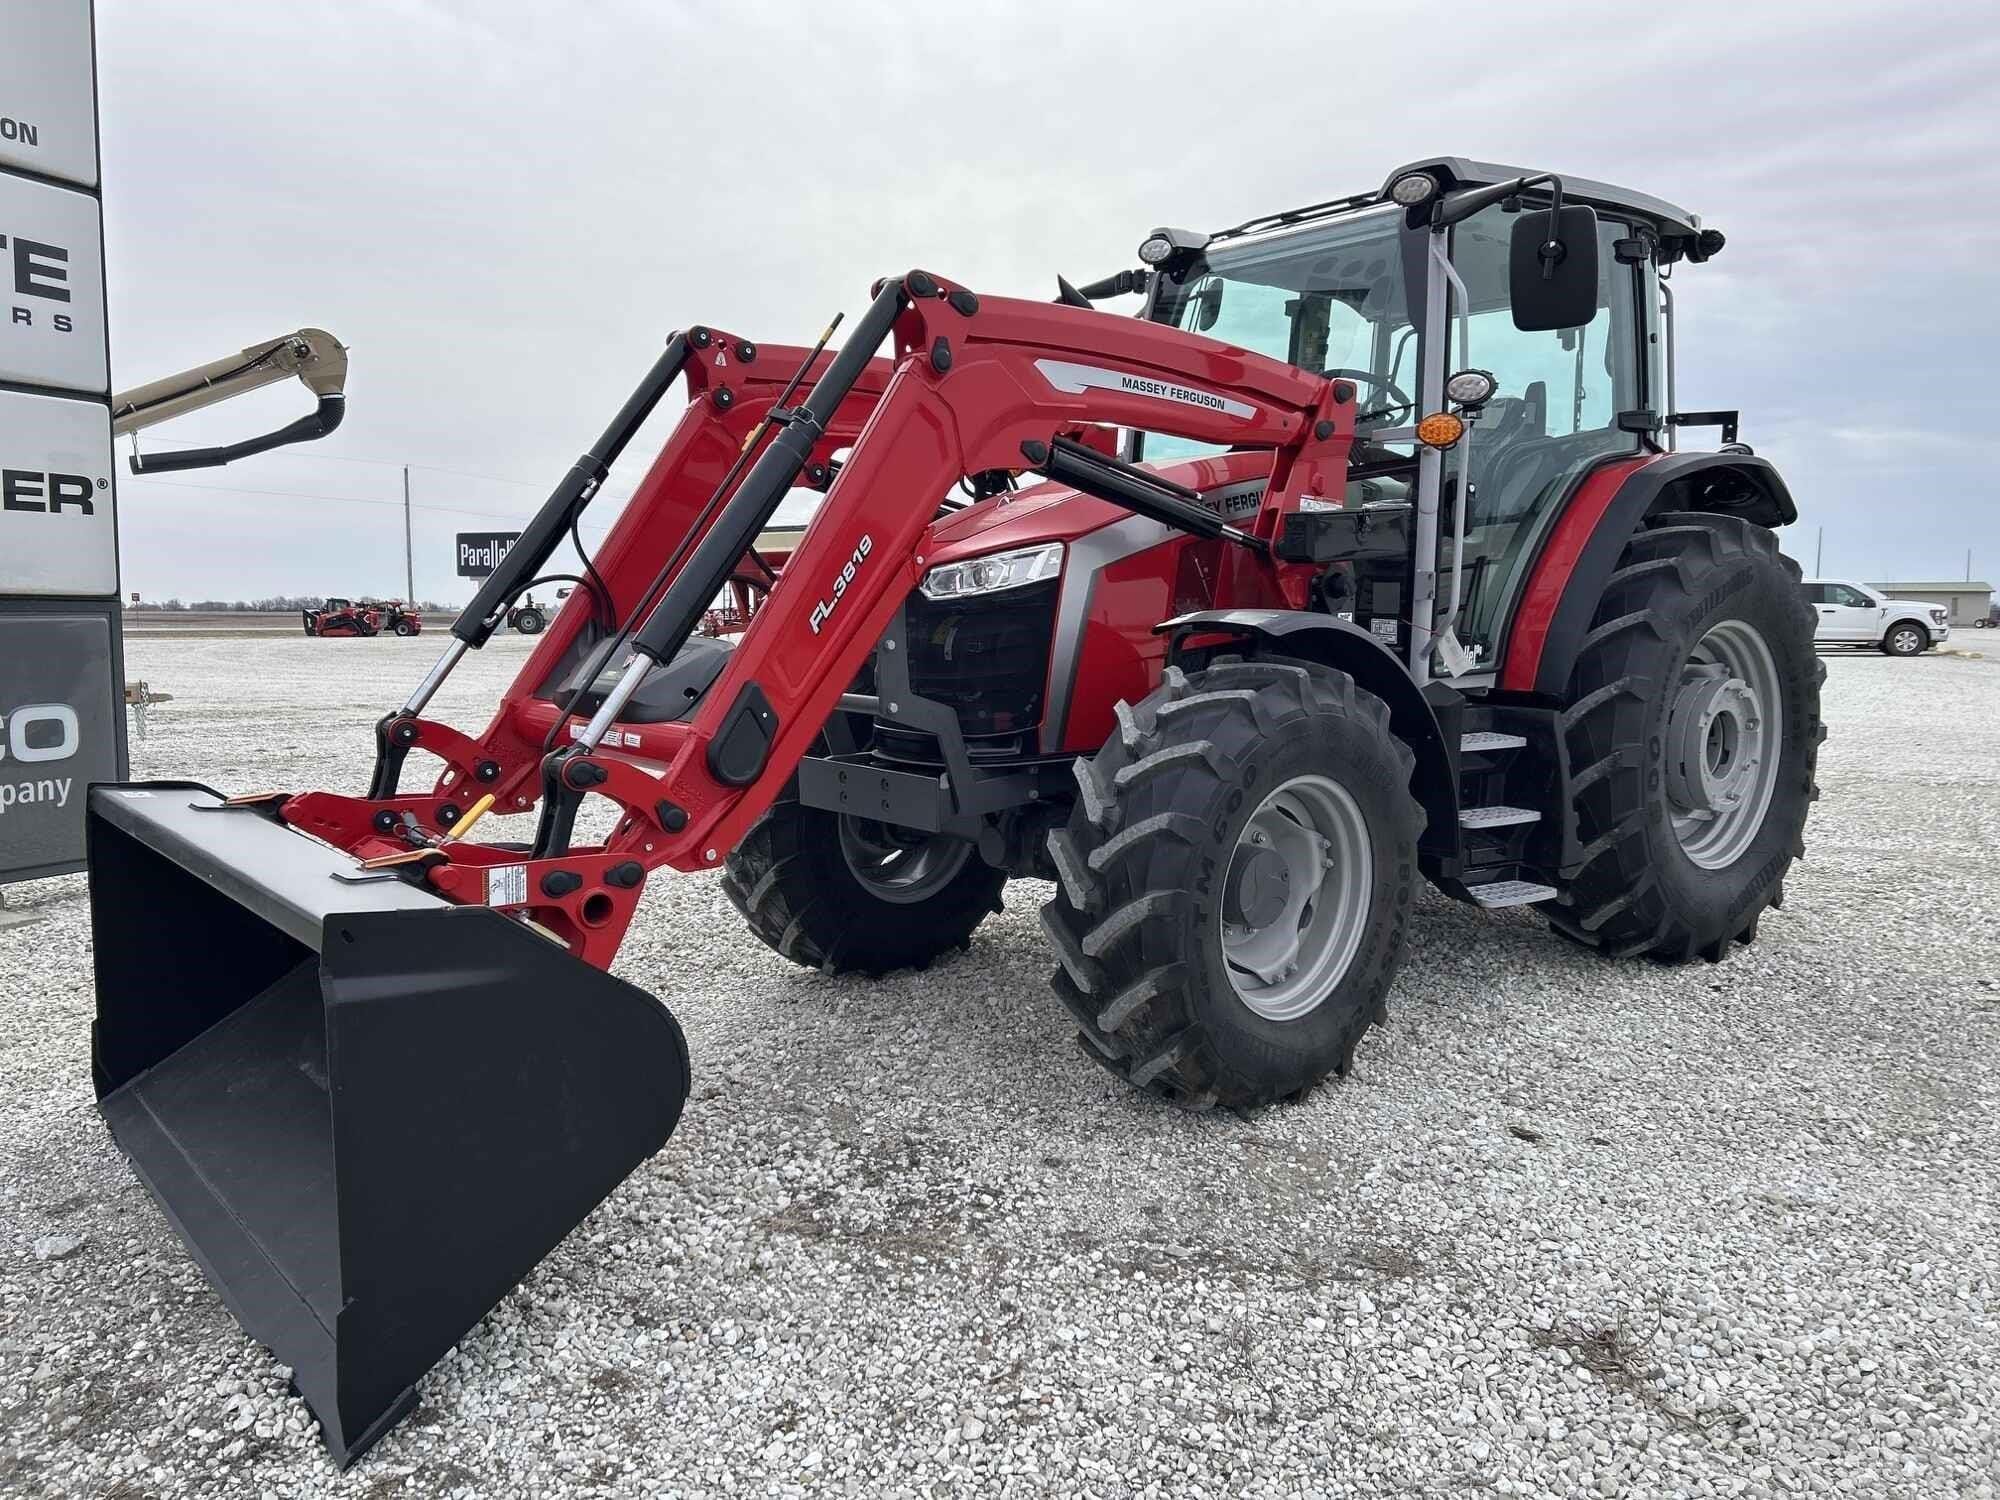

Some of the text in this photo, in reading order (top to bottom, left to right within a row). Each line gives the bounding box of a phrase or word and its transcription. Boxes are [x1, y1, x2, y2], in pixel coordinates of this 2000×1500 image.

[0, 117, 38, 147] ON
[1121, 377, 1225, 411] MASSEY FERGUSON
[808, 533, 873, 635] FL.3819
